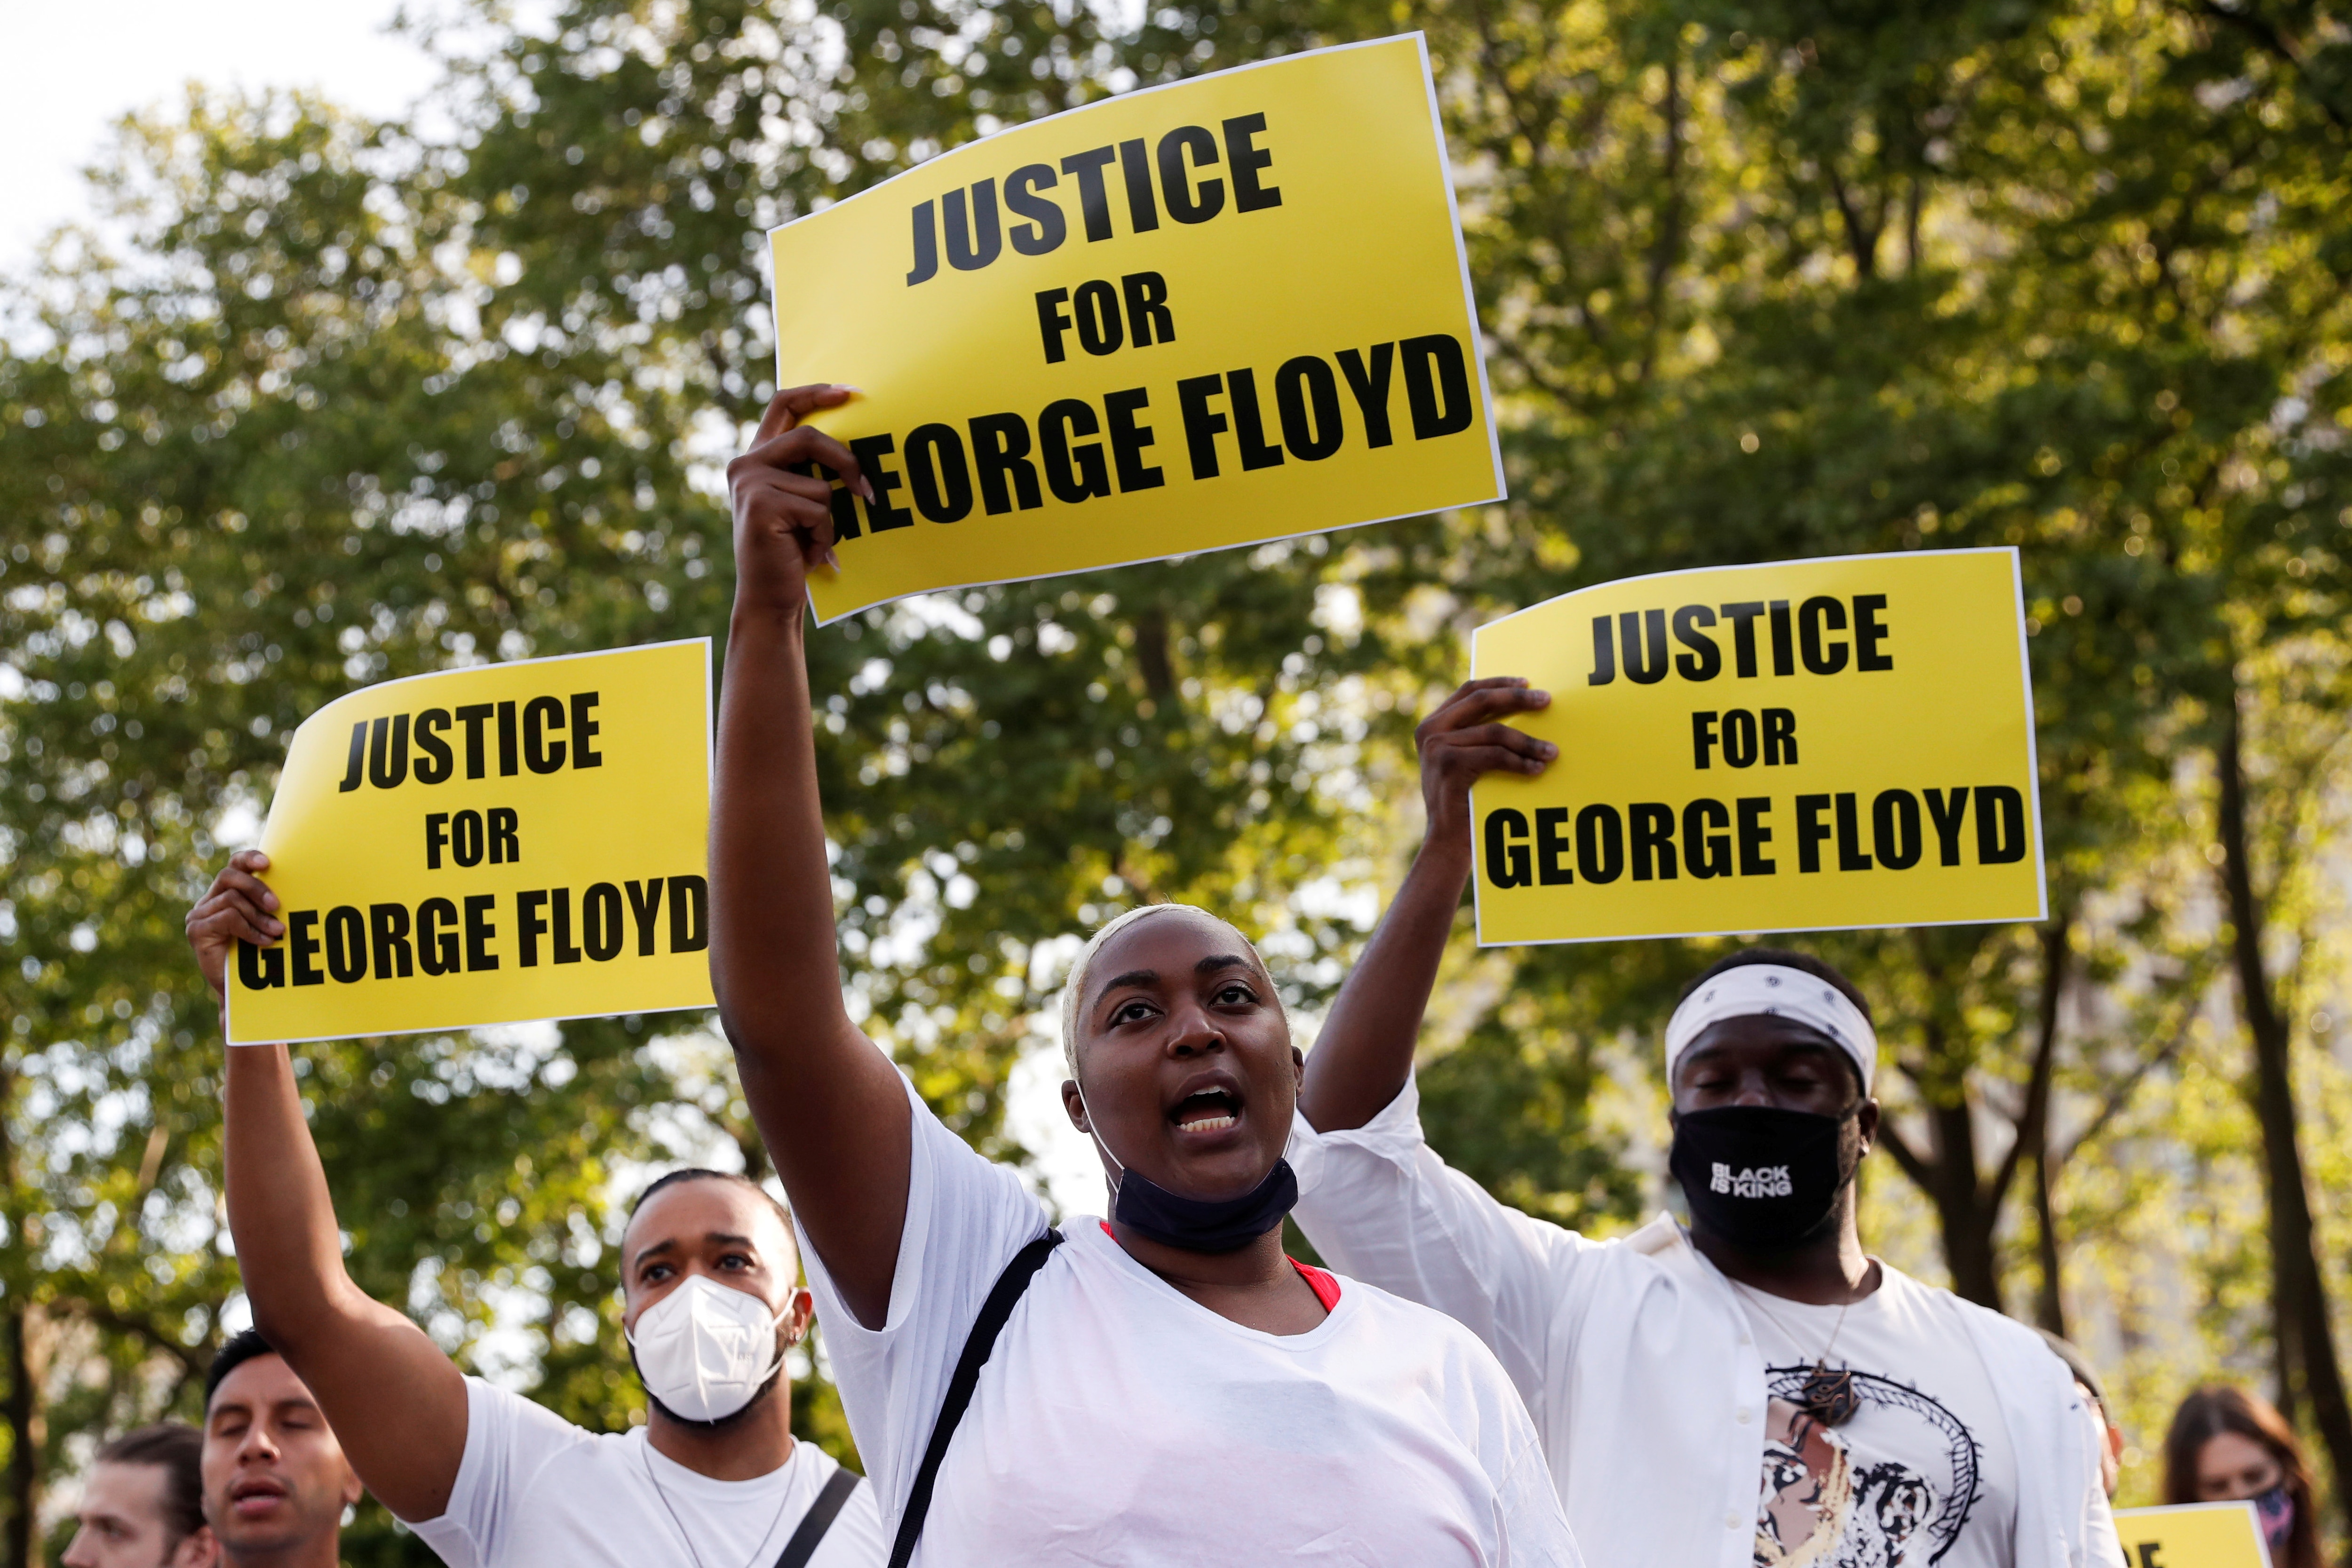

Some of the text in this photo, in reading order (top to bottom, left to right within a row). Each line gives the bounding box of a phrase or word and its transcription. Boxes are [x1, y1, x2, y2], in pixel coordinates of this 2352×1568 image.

[906, 111, 1282, 287] JUSTICE
[1035, 271, 1176, 364] FOR
[1176, 334, 1473, 480] FLOYD
[1588, 594, 1894, 686] JUSTICE
[339, 691, 602, 793] JUSTICE
[1692, 708, 1798, 770] FOR
[426, 807, 519, 869] FOR
[1485, 785, 2026, 889] GEORGE FLOYD
[238, 875, 709, 990] GEORGE FLOYD
[1710, 1176, 1793, 1198] IS KING
[1711, 1162, 1791, 1184] BLACK
